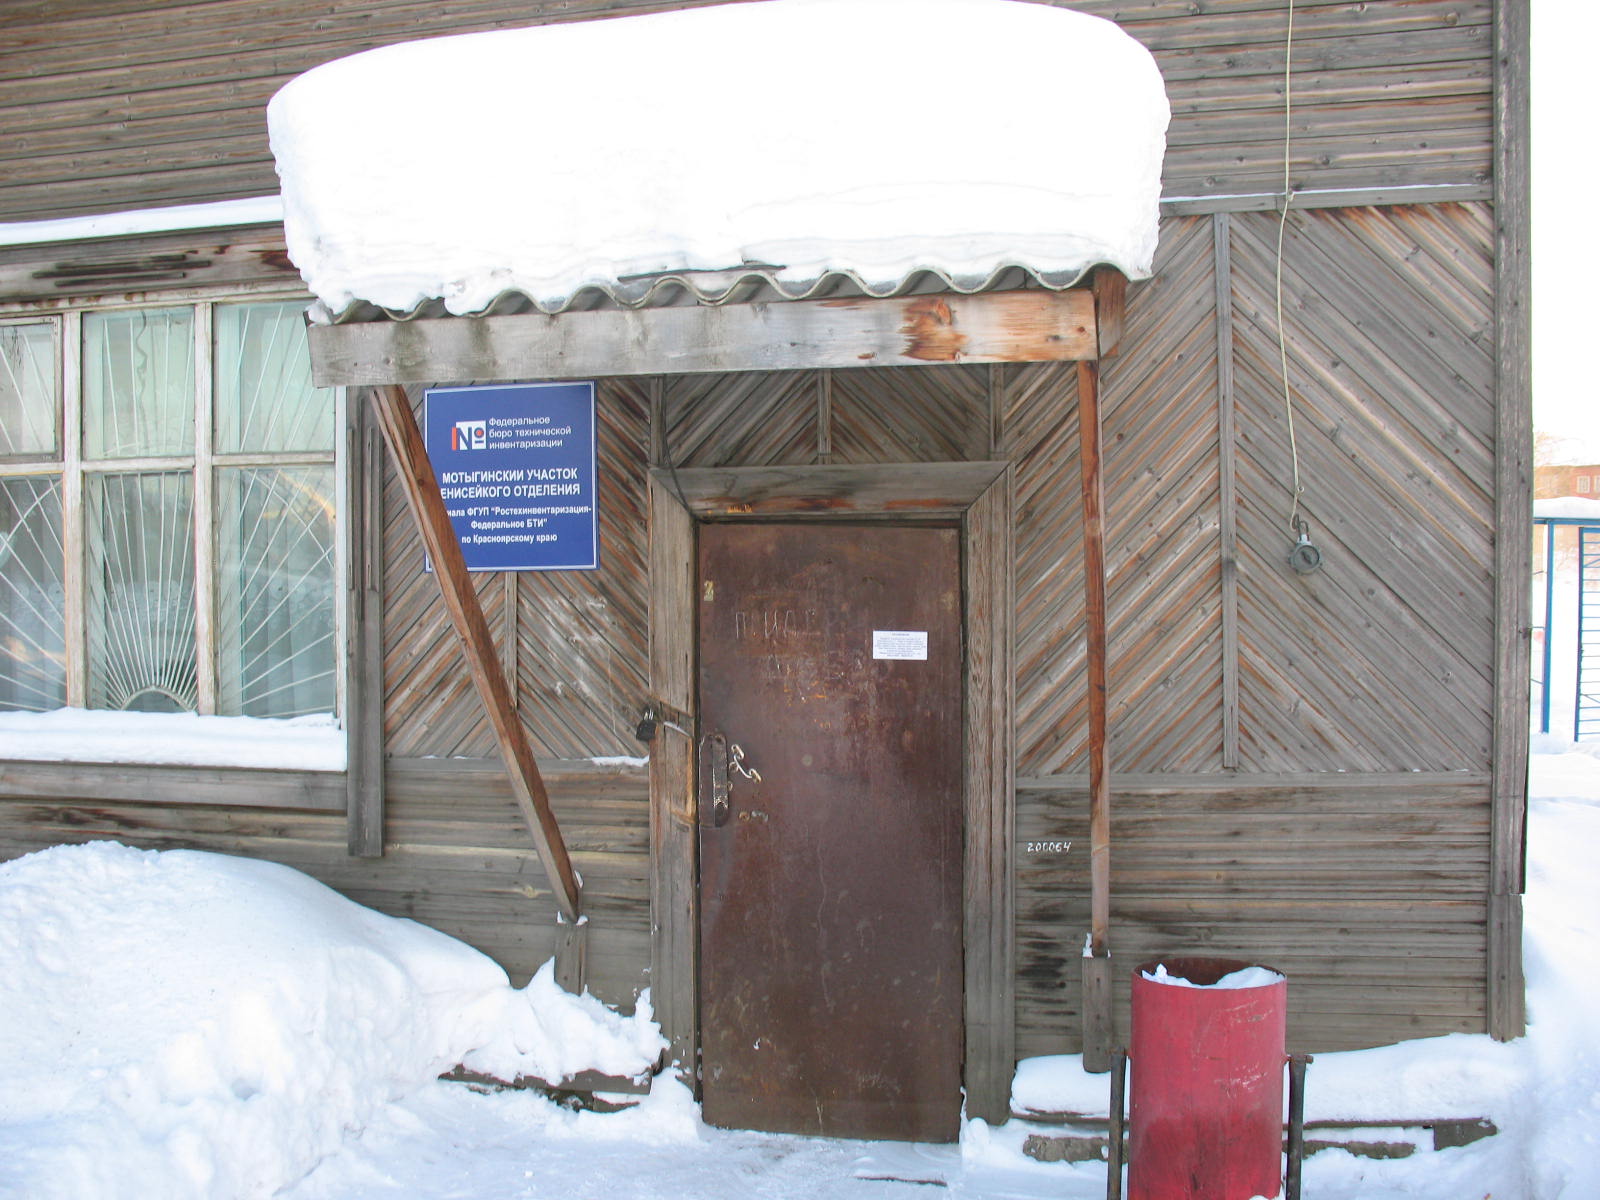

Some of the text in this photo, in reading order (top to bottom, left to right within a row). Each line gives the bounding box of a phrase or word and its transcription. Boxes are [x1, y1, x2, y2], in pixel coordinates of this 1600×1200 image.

[488, 416, 551, 428] Федеральное
[488, 426, 572, 439] бюро технической
[489, 439, 563, 450] инвентаризации
[526, 467, 578, 480] УЧАСТОК
[513, 483, 580, 499] ОТДЕЛЕНИЯ
[467, 506, 489, 516] ФГУП
[470, 520, 525, 531] Федеральное
[473, 534, 535, 545] Красноярскому
[536, 534, 558, 544] краю
